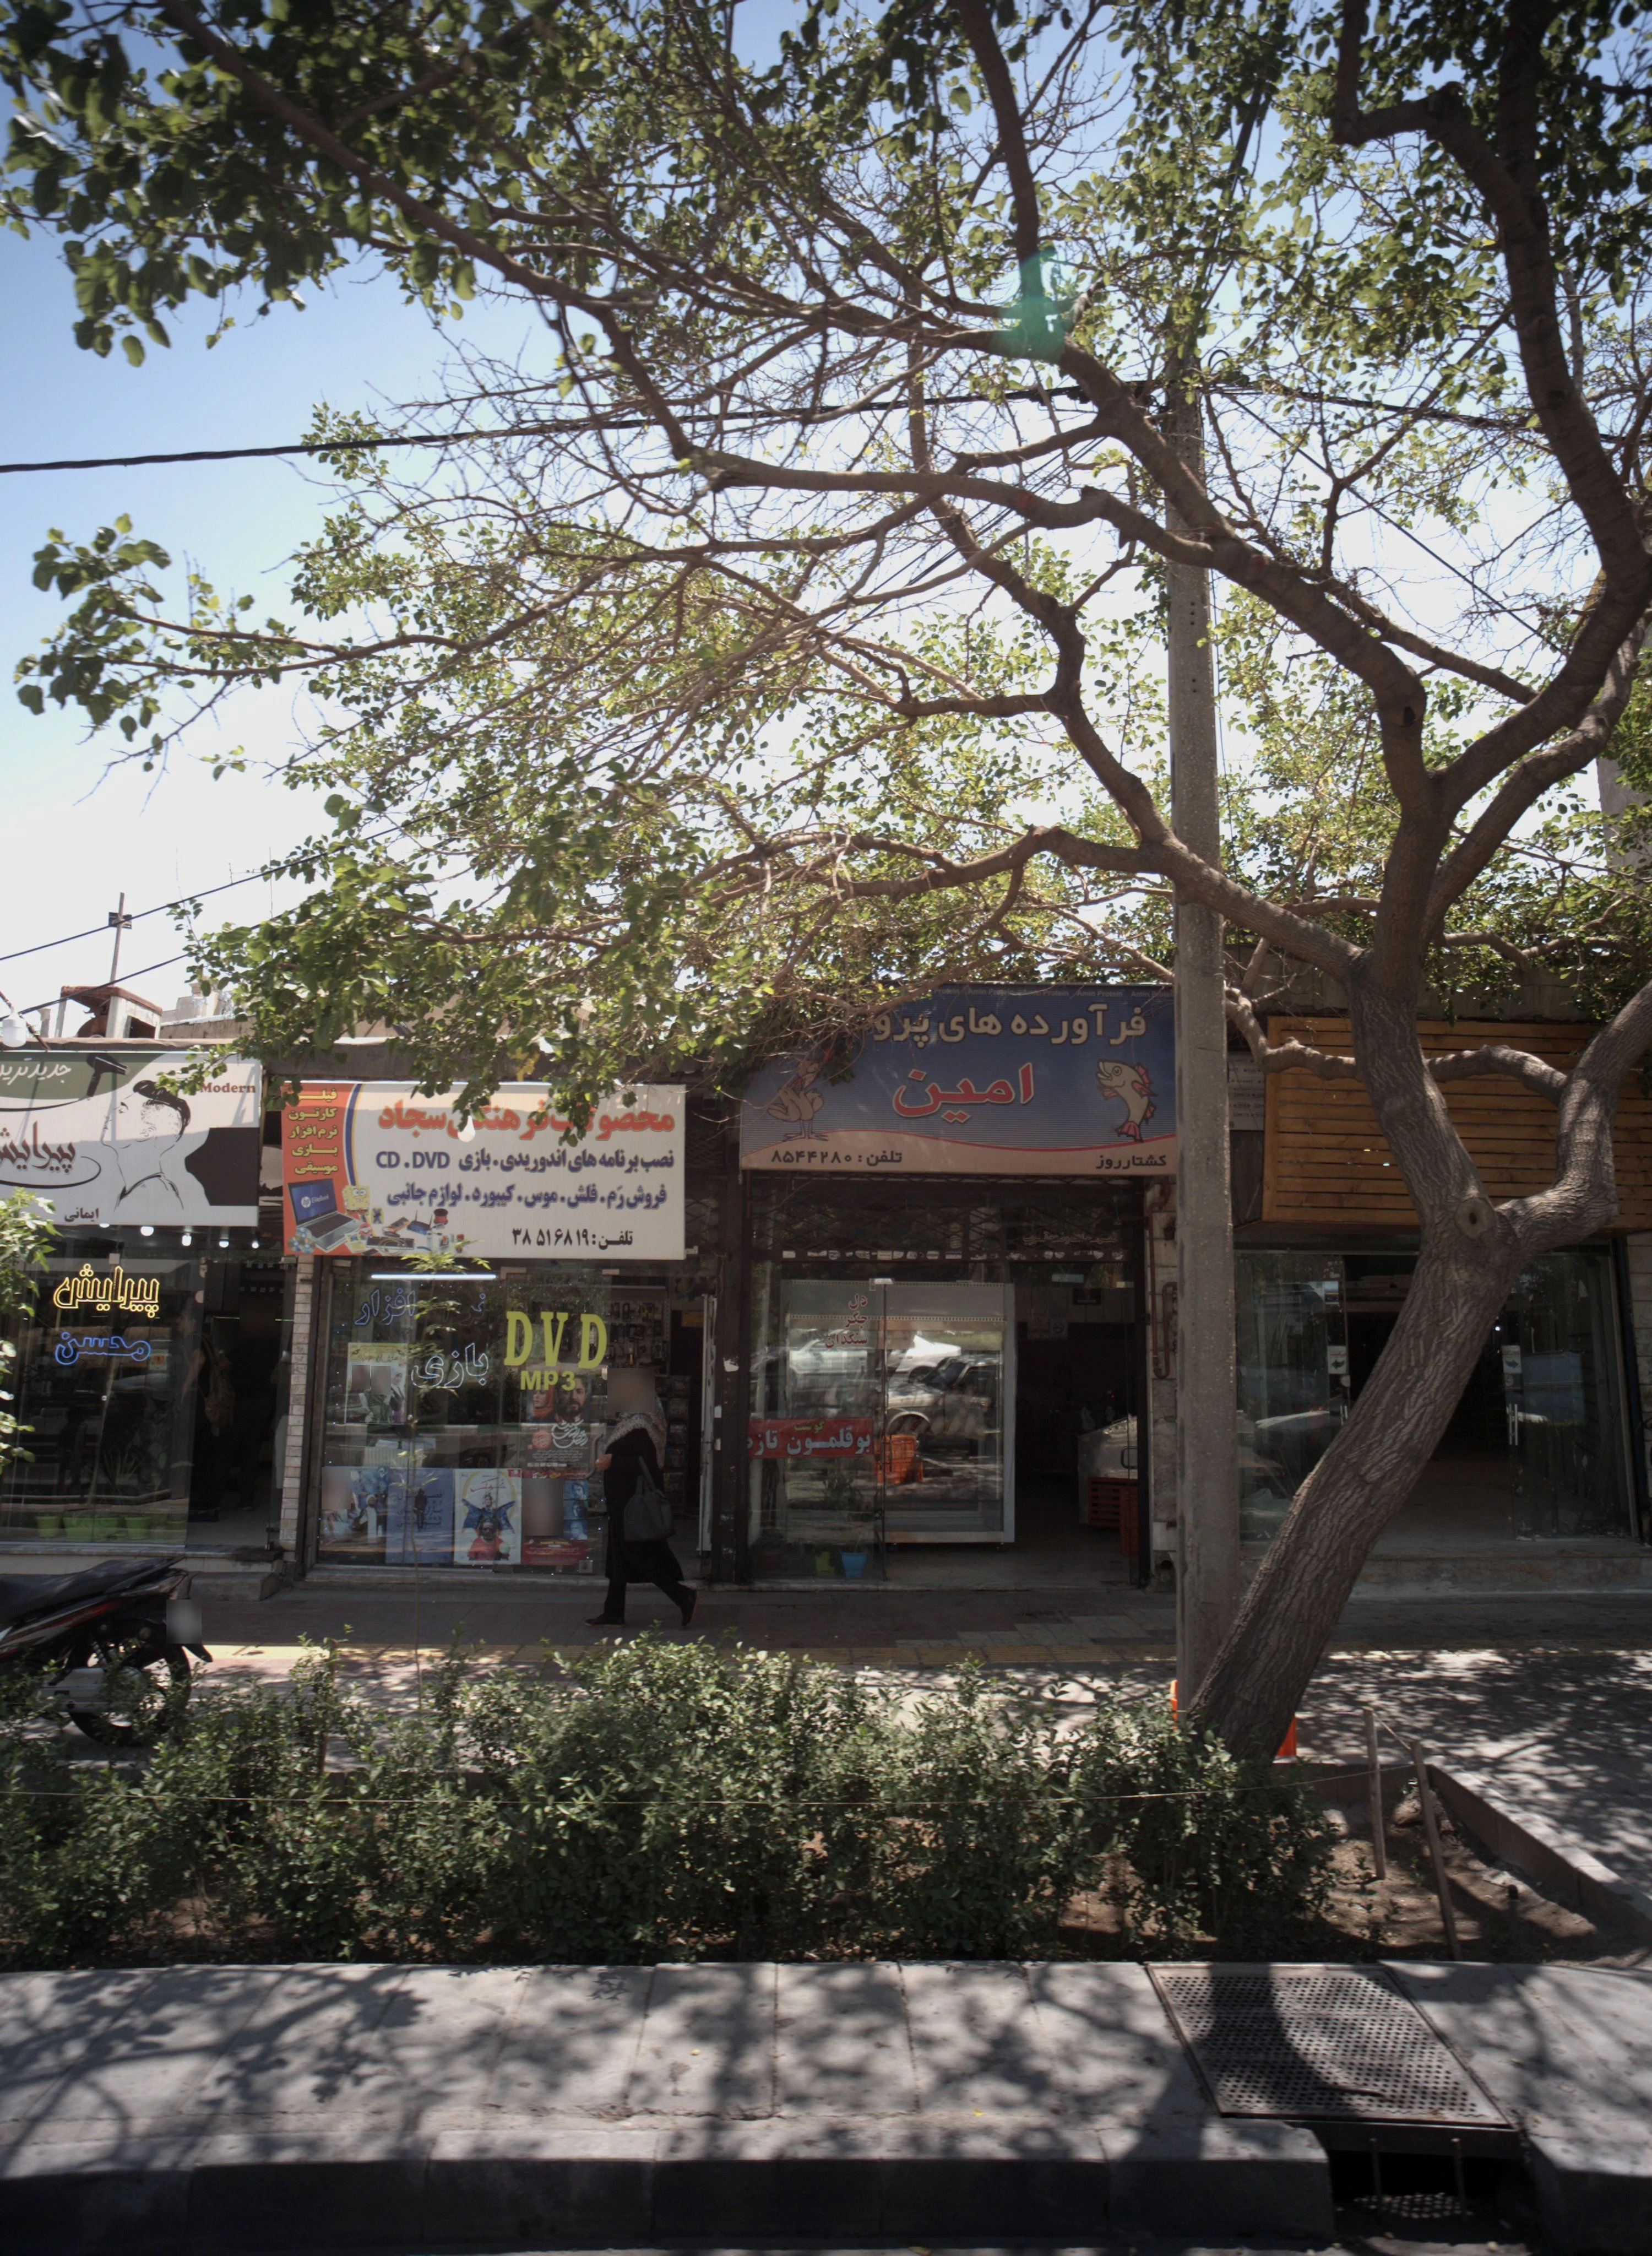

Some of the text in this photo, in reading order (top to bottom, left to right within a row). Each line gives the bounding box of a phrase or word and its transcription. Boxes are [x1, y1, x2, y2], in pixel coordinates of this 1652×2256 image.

[939, 1007, 1002, 1043] های
[200, 1082, 256, 1093] Modern
[298, 1089, 338, 1102] فیل
[892, 1062, 1034, 1123] امین
[288, 1107, 338, 1121] کارتون
[378, 1099, 447, 1138] سجاد
[291, 1143, 338, 1157] بازی
[568, 1149, 597, 1173] های
[640, 1149, 675, 1173] نصب
[771, 1150, 852, 1164] ۸۵۴۴۲۸۰
[295, 1162, 338, 1174] موسیقی
[387, 1182, 426, 1207] جانبی
[429, 1183, 463, 1207] لوازم
[626, 1184, 667, 1210] فروش
[64, 1207, 100, 1222] ایمانی
[53, 1263, 160, 1319] پیرایش
[848, 1293, 868, 1310] دل
[55, 1331, 151, 1365] محسن
[504, 1311, 607, 1369] DVD
[411, 1342, 490, 1389] بازی
[519, 1369, 577, 1391] MP3
[786, 1425, 871, 1456] بوقلمون
